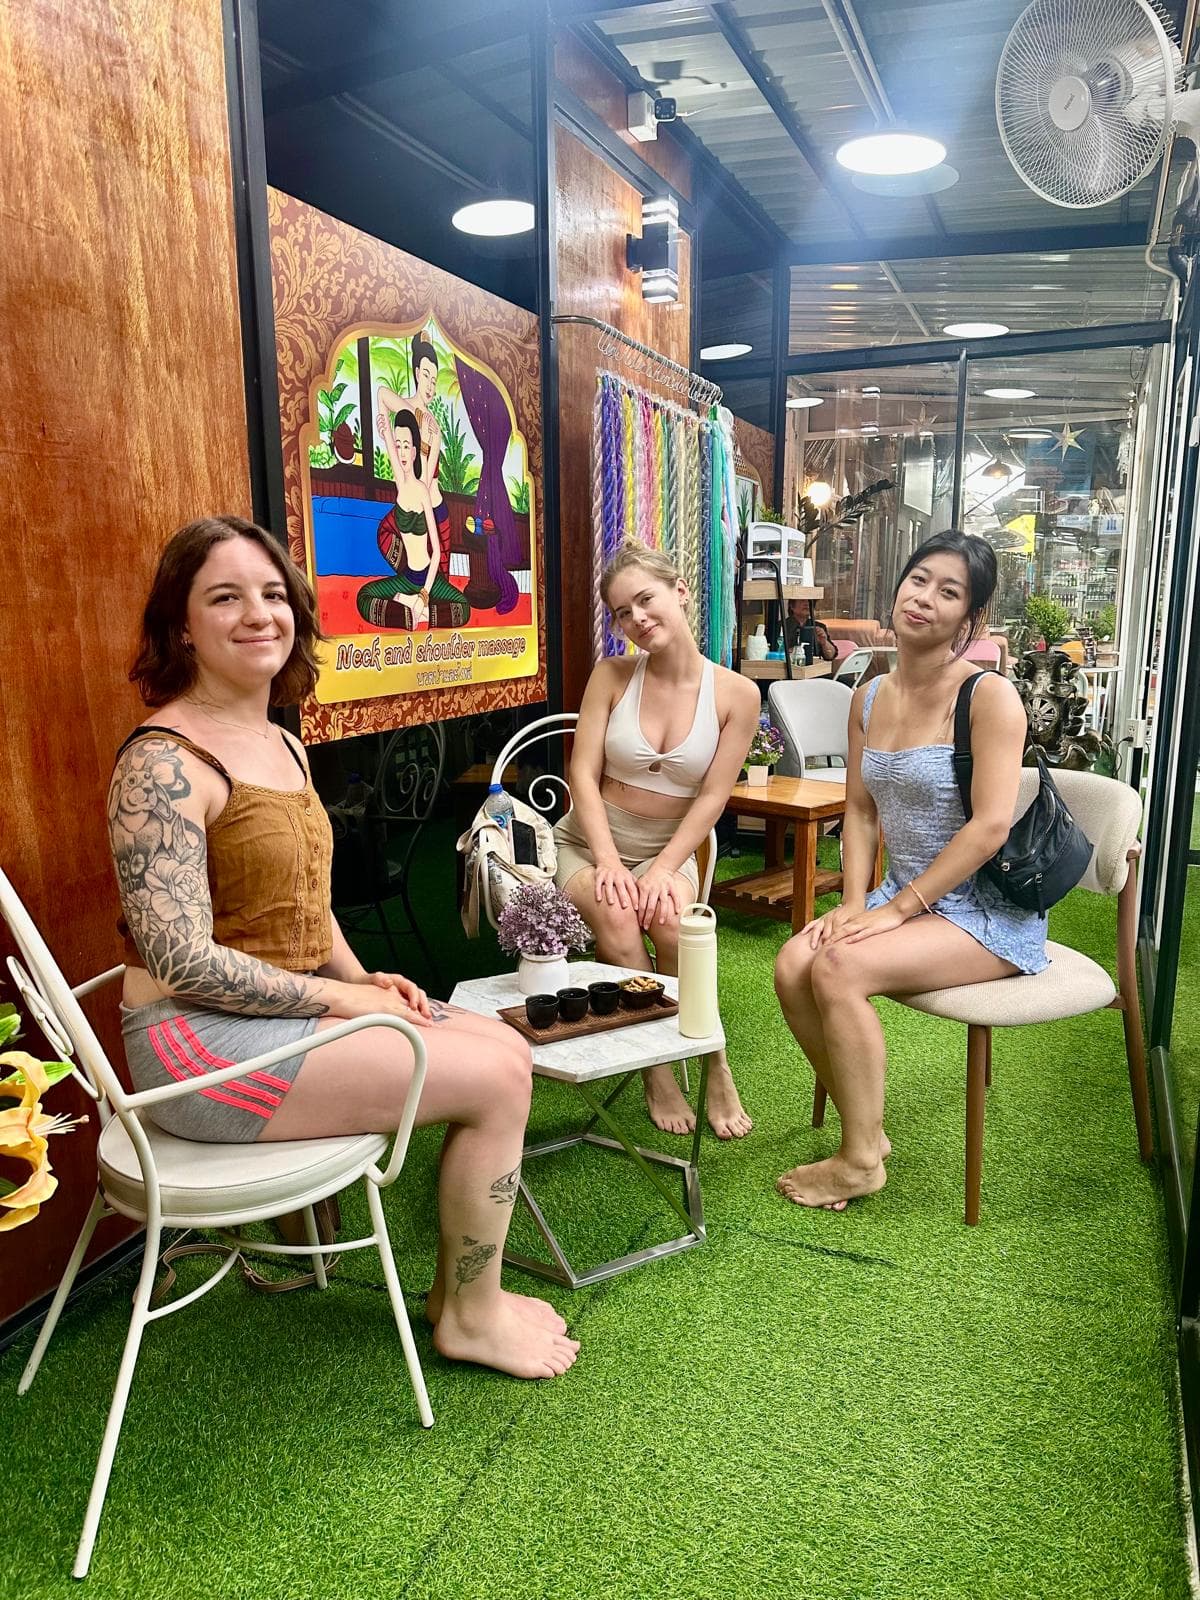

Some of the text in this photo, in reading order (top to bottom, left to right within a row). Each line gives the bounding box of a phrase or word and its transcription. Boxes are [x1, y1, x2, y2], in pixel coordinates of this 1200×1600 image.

[337, 634, 526, 671] Neck and shoulder massage
